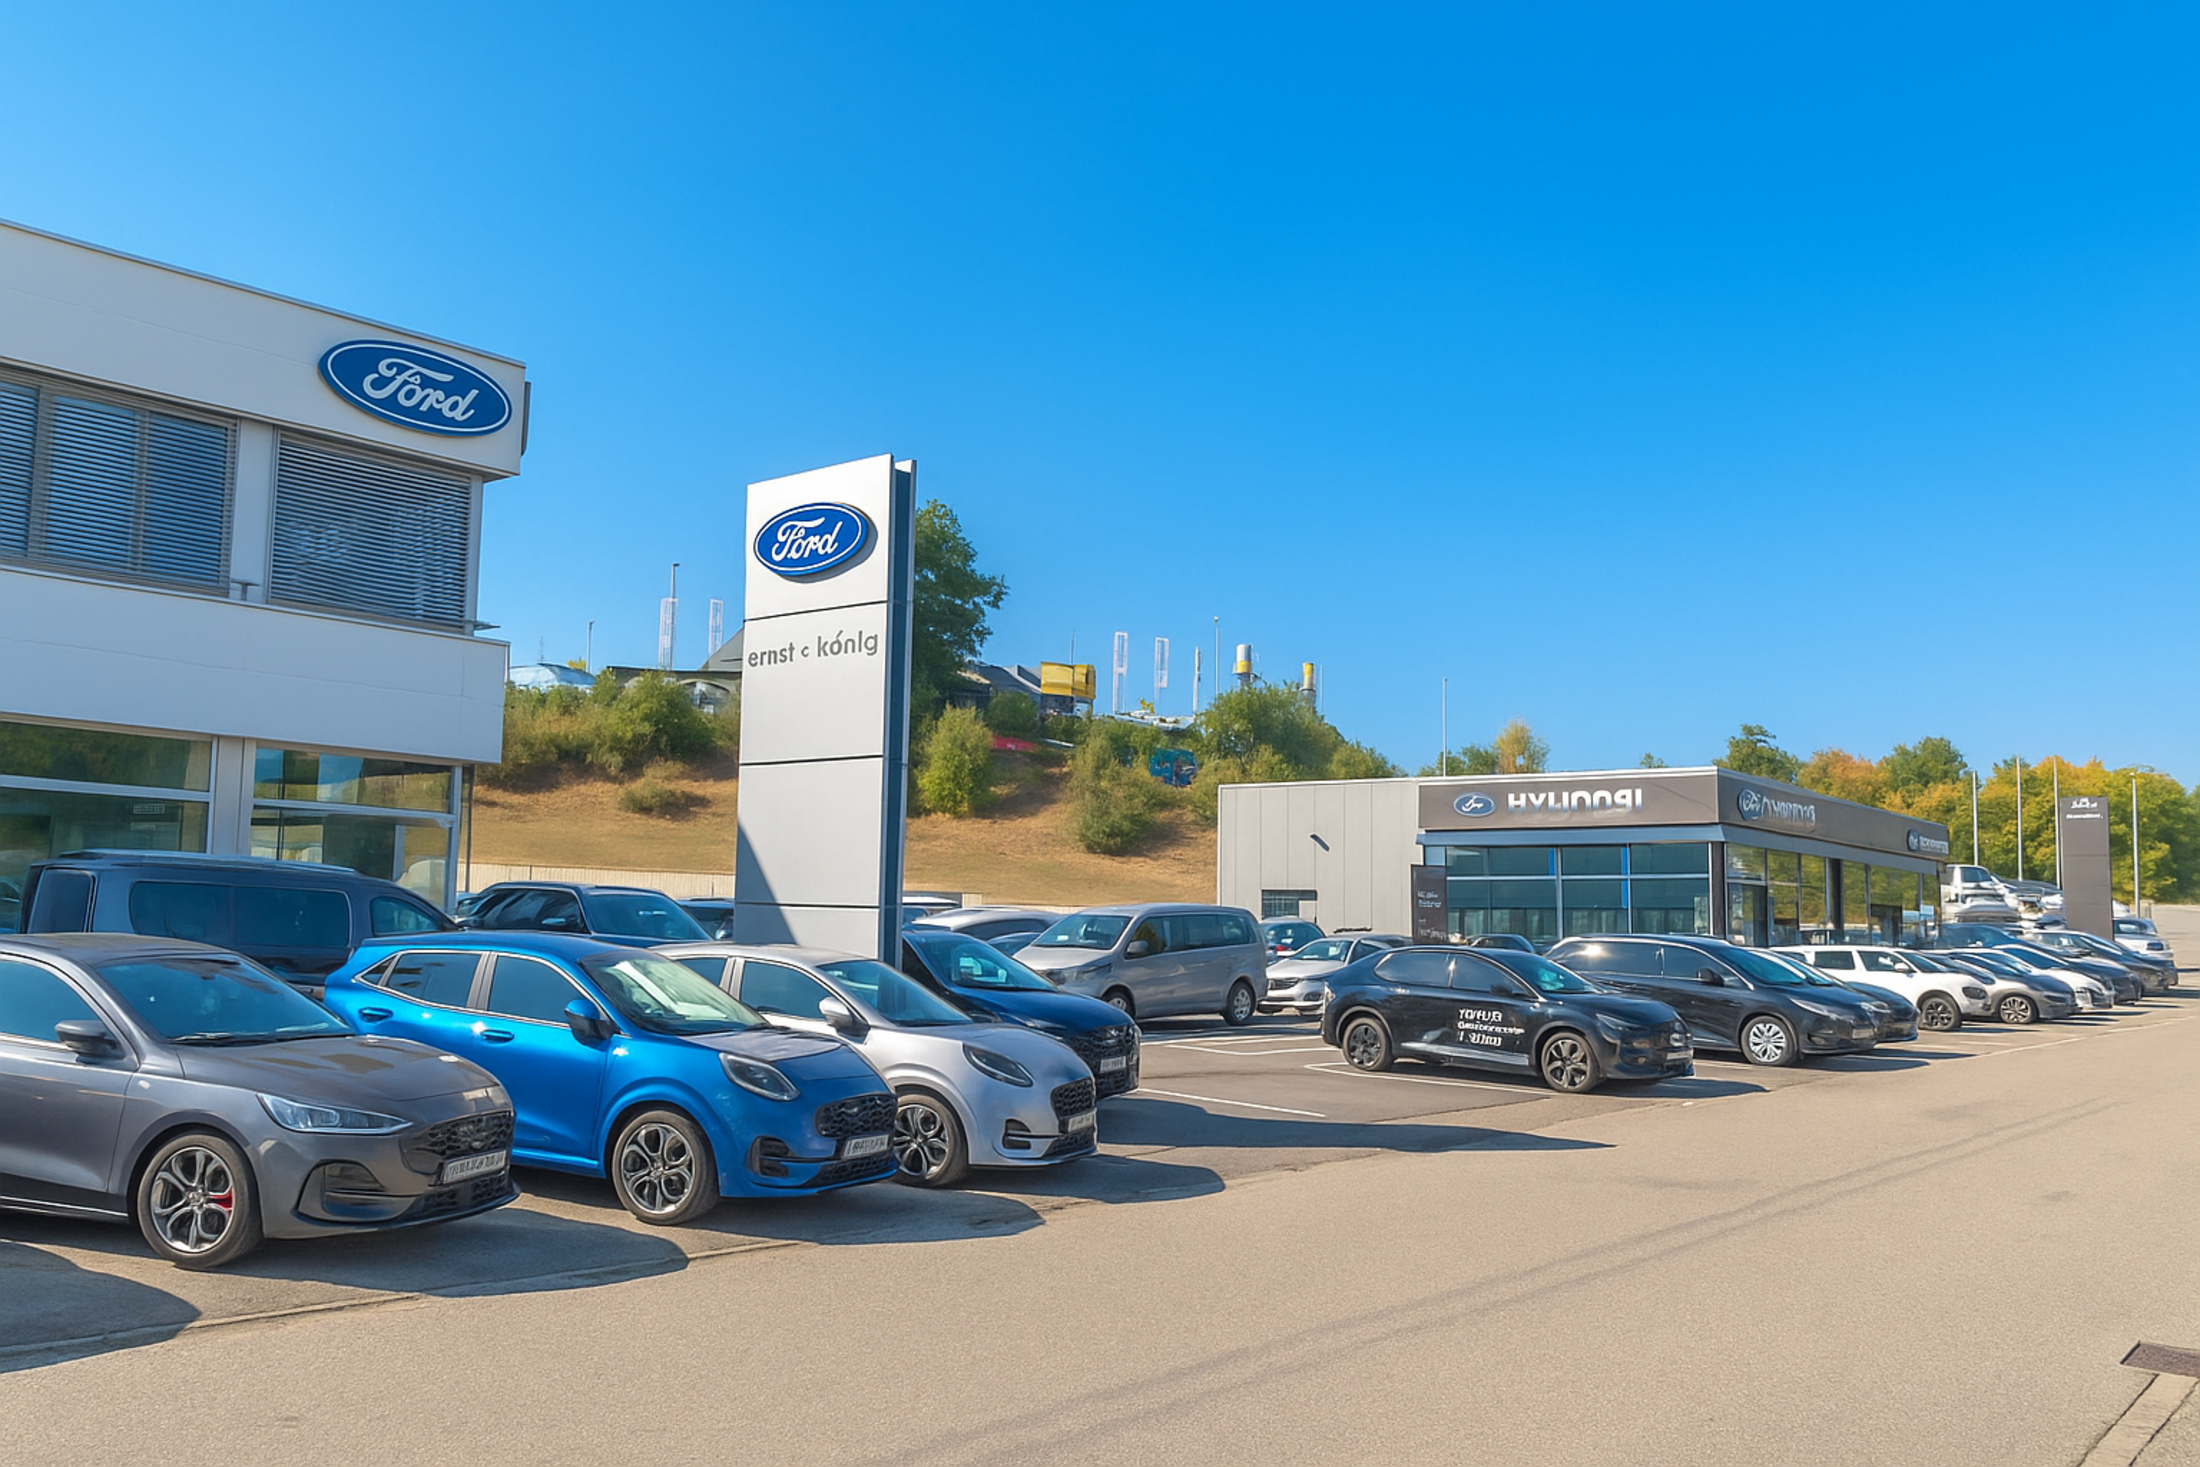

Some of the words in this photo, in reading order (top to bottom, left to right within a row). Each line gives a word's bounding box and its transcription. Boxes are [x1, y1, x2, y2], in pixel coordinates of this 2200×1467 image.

[362, 357, 480, 422] Ford
[771, 516, 843, 562] Ford
[747, 641, 796, 668] ernst
